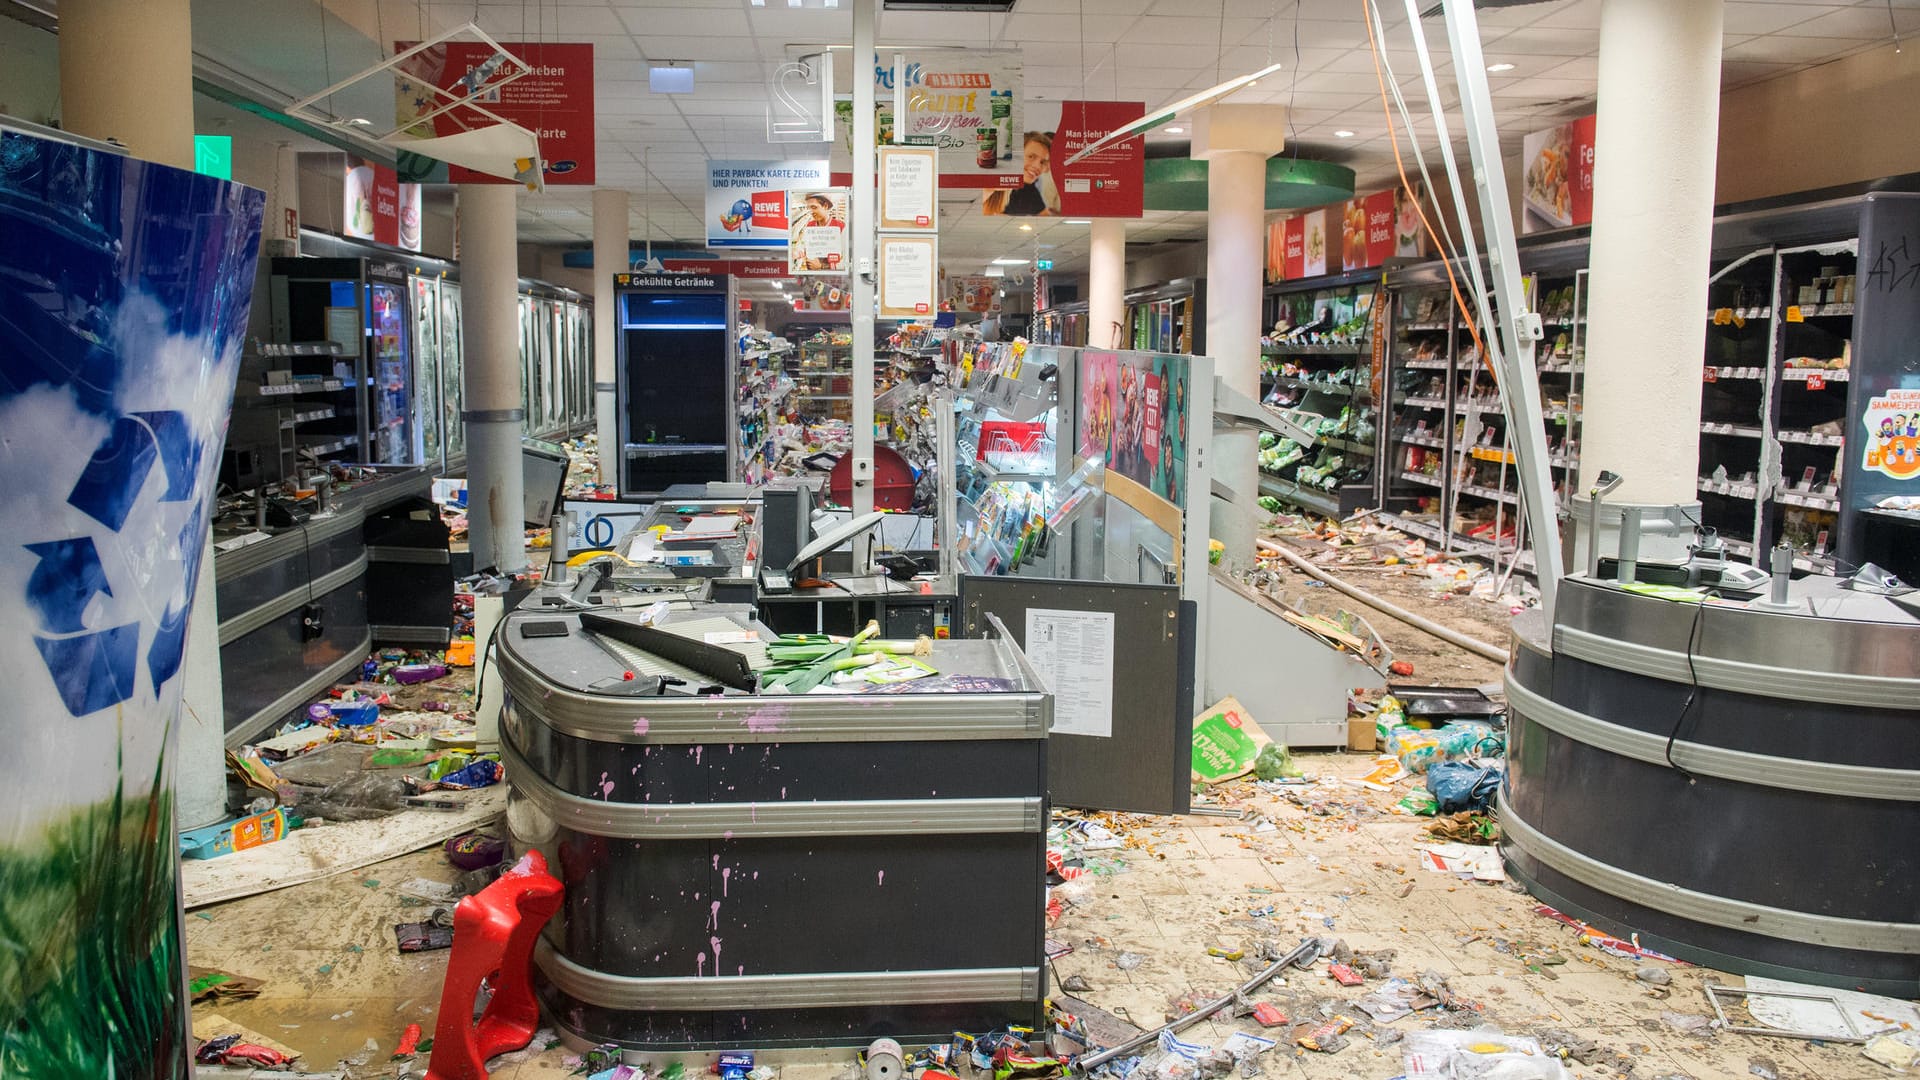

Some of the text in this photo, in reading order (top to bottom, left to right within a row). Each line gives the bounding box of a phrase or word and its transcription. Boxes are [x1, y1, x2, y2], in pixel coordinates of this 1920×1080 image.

[910, 89, 977, 113] Bunt
[1065, 130, 1082, 138] Man
[1084, 130, 1102, 138] sieht
[713, 170, 820, 178] HIER PAYBACK KARTE ZEIGEN
[731, 180, 768, 188] PUNKTEN!
[754, 202, 781, 213] REWE
[1370, 210, 1391, 225] Saftiger
[1370, 227, 1391, 244] leben.
[744, 265, 781, 275] Putzmittel
[632, 277, 715, 288] Gekühlte Getränke
